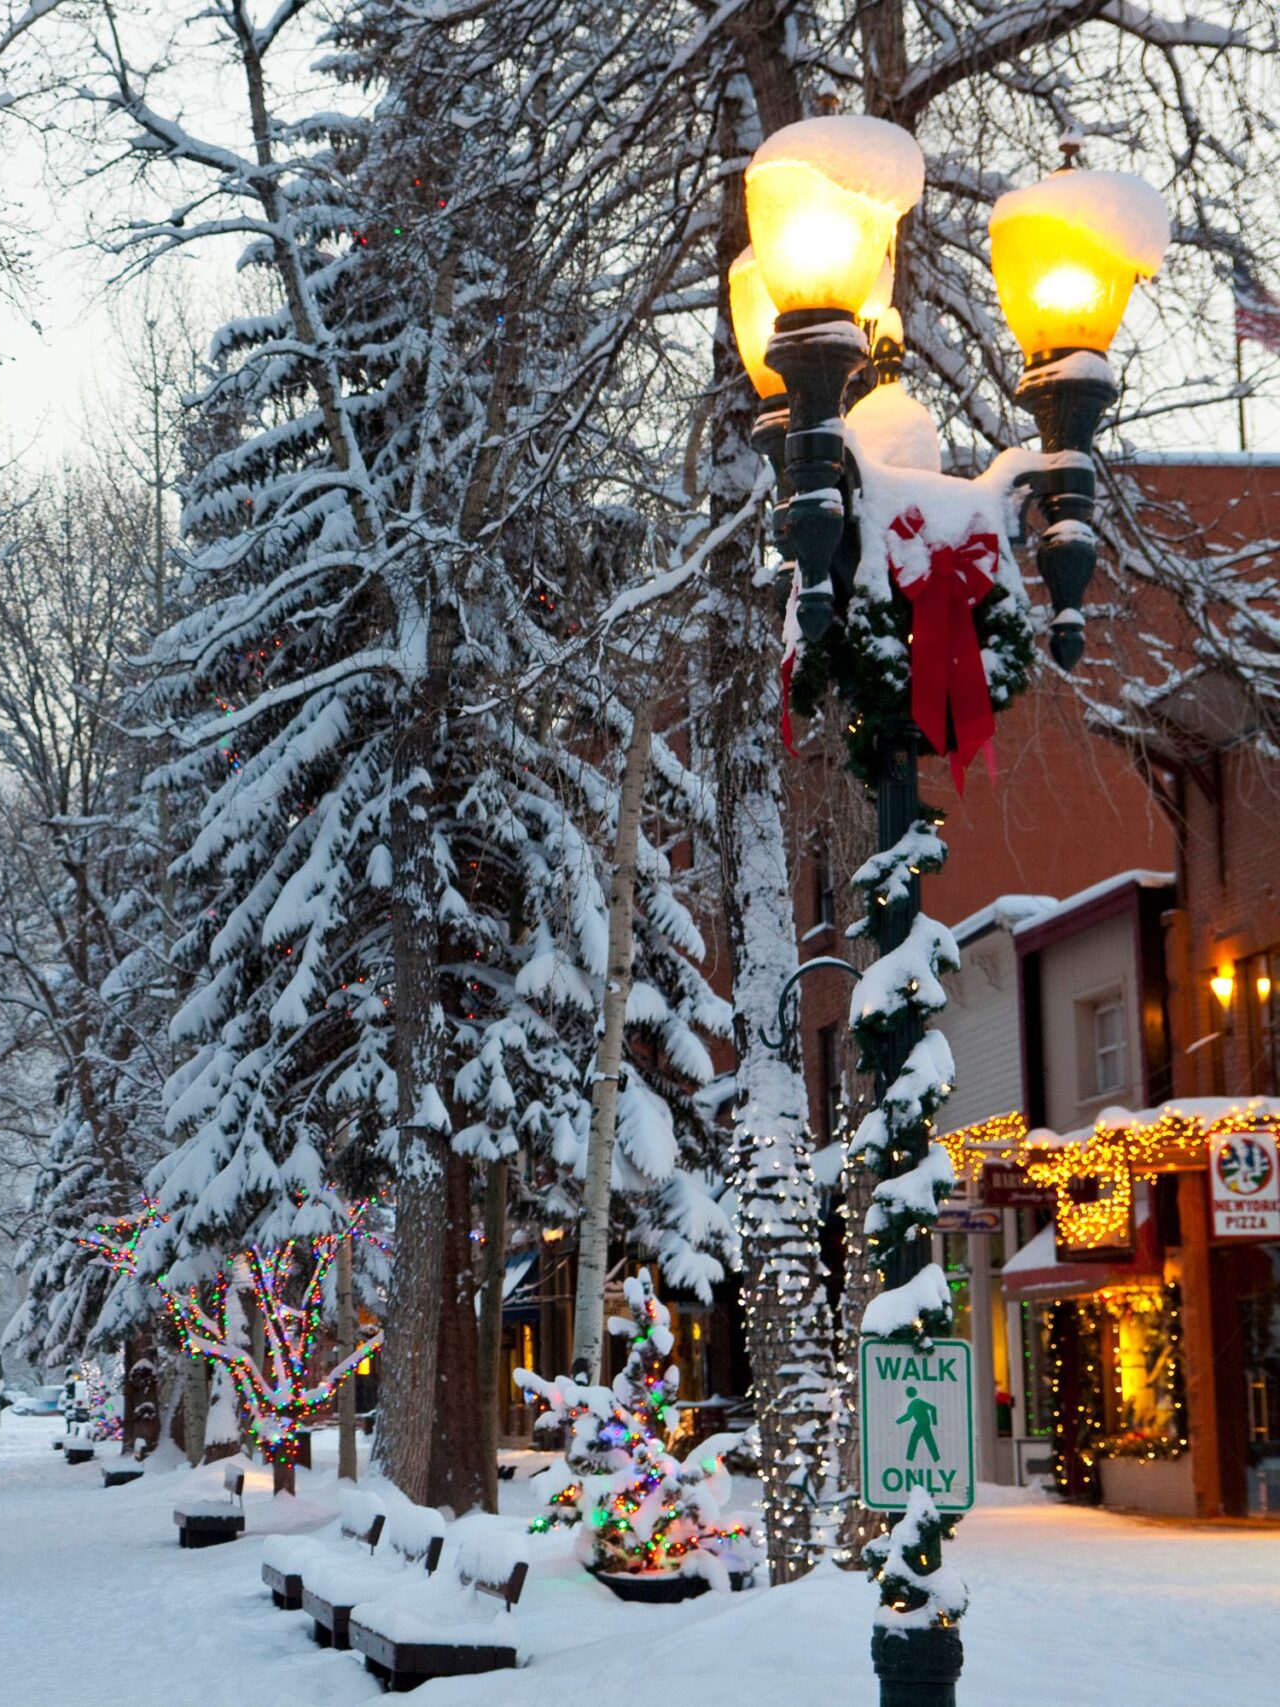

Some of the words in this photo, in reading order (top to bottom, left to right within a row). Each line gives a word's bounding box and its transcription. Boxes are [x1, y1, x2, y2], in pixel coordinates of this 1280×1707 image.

[1226, 1215, 1268, 1229] PIZZA
[875, 1356, 958, 1382] WALK
[882, 1467, 957, 1493] ONLY
